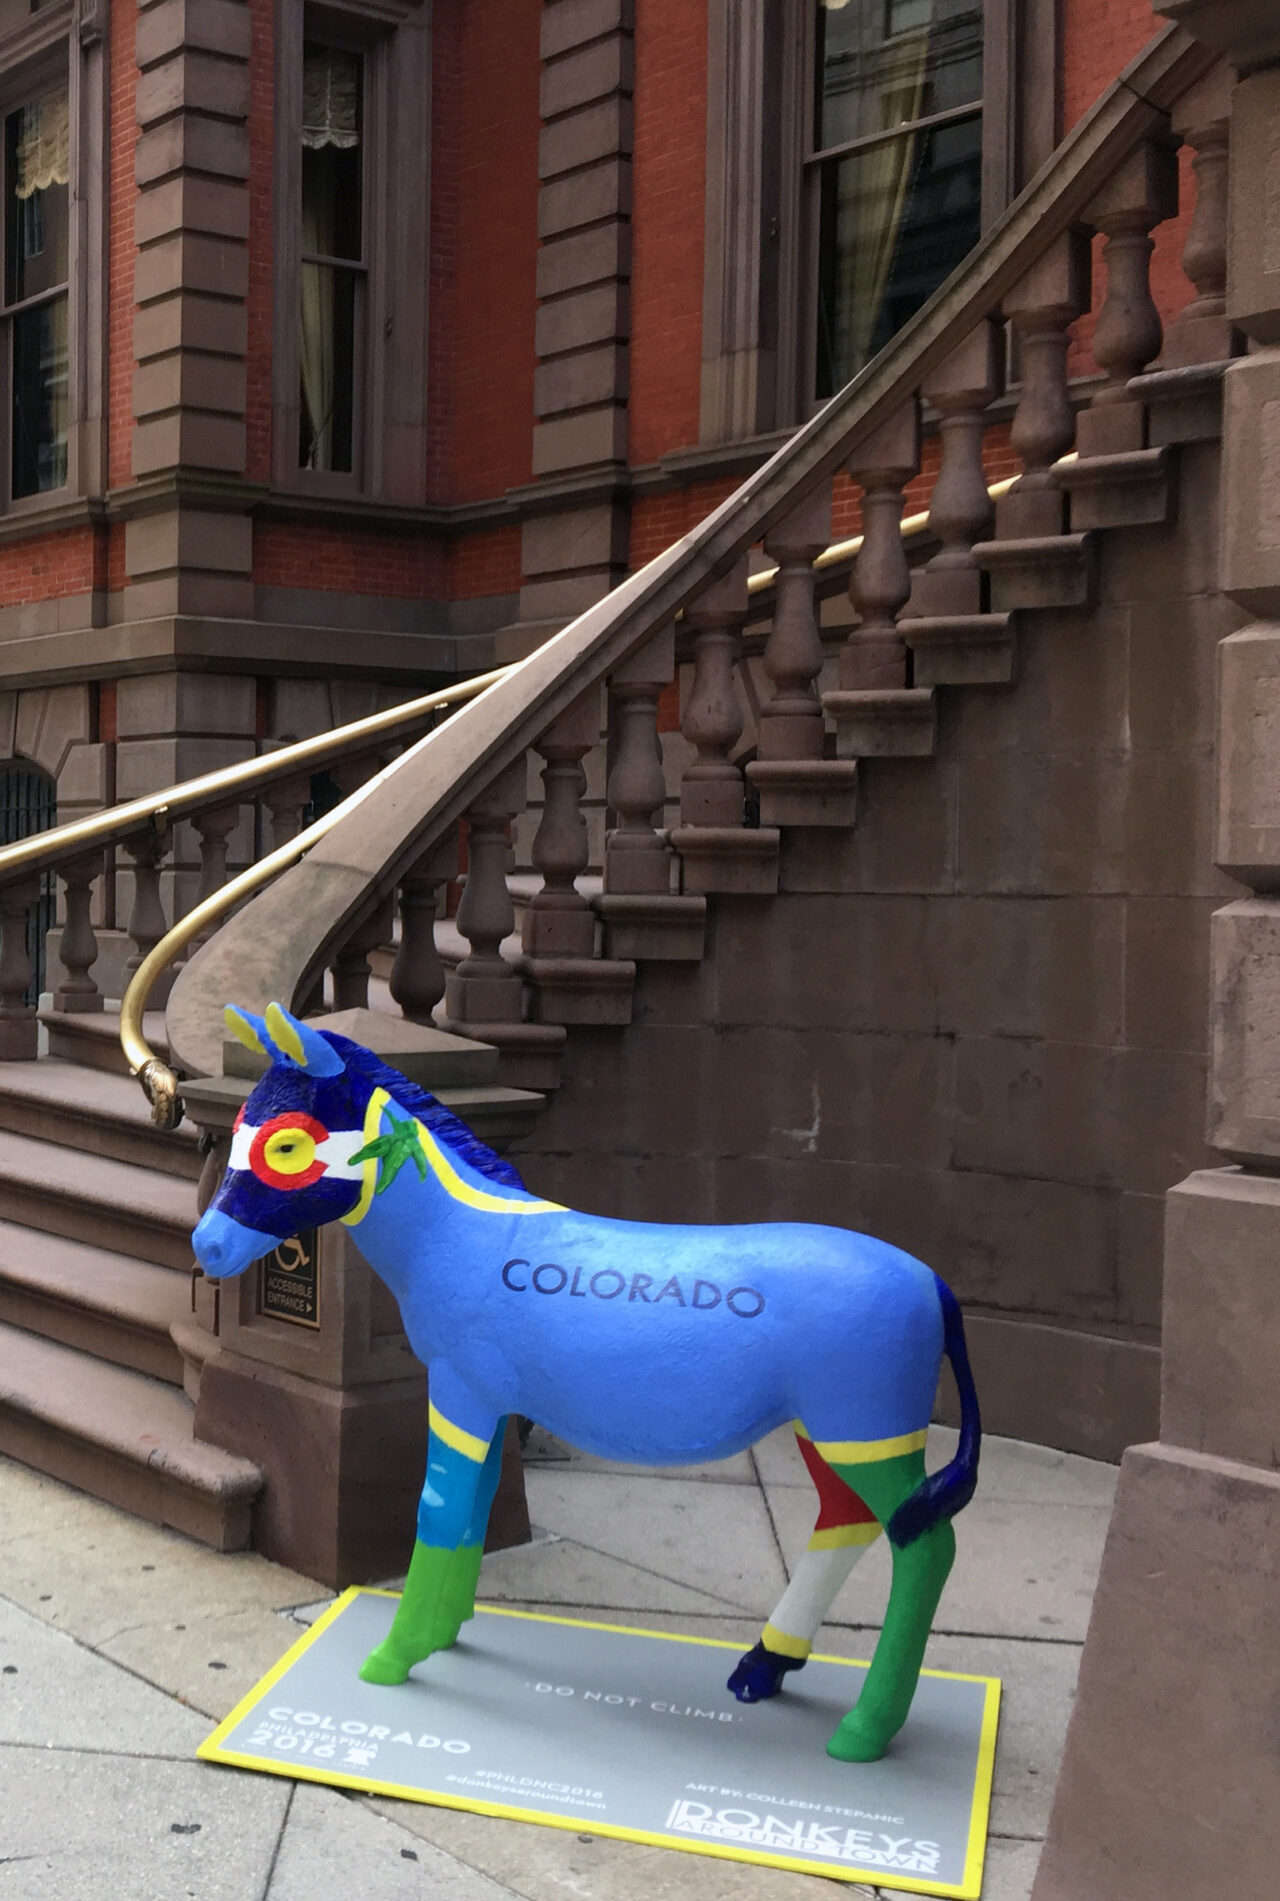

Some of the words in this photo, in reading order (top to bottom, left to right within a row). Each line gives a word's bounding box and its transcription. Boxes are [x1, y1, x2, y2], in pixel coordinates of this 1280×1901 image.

[267, 1291, 305, 1312] ENTRANCE
[268, 1277, 313, 1299] ACCESSIBLE
[502, 1258, 766, 1319] COLORADO
[584, 1690, 642, 1707] NOT
[247, 1730, 336, 1758] 2016
[259, 1721, 379, 1751] PHILADELPHIA
[268, 1706, 472, 1754] COLORADO
[446, 1774, 607, 1810] #donkeysaroundtown
[475, 1769, 604, 1799] #PHLDNC2016
[686, 1782, 718, 1793] ART
[746, 1792, 821, 1811] COLLEEN
[823, 1805, 905, 1825] STEPANIC
[666, 1799, 941, 1860] DONKEYS
[673, 1819, 820, 1852] AROUND
[836, 1844, 940, 1874] TOWN
